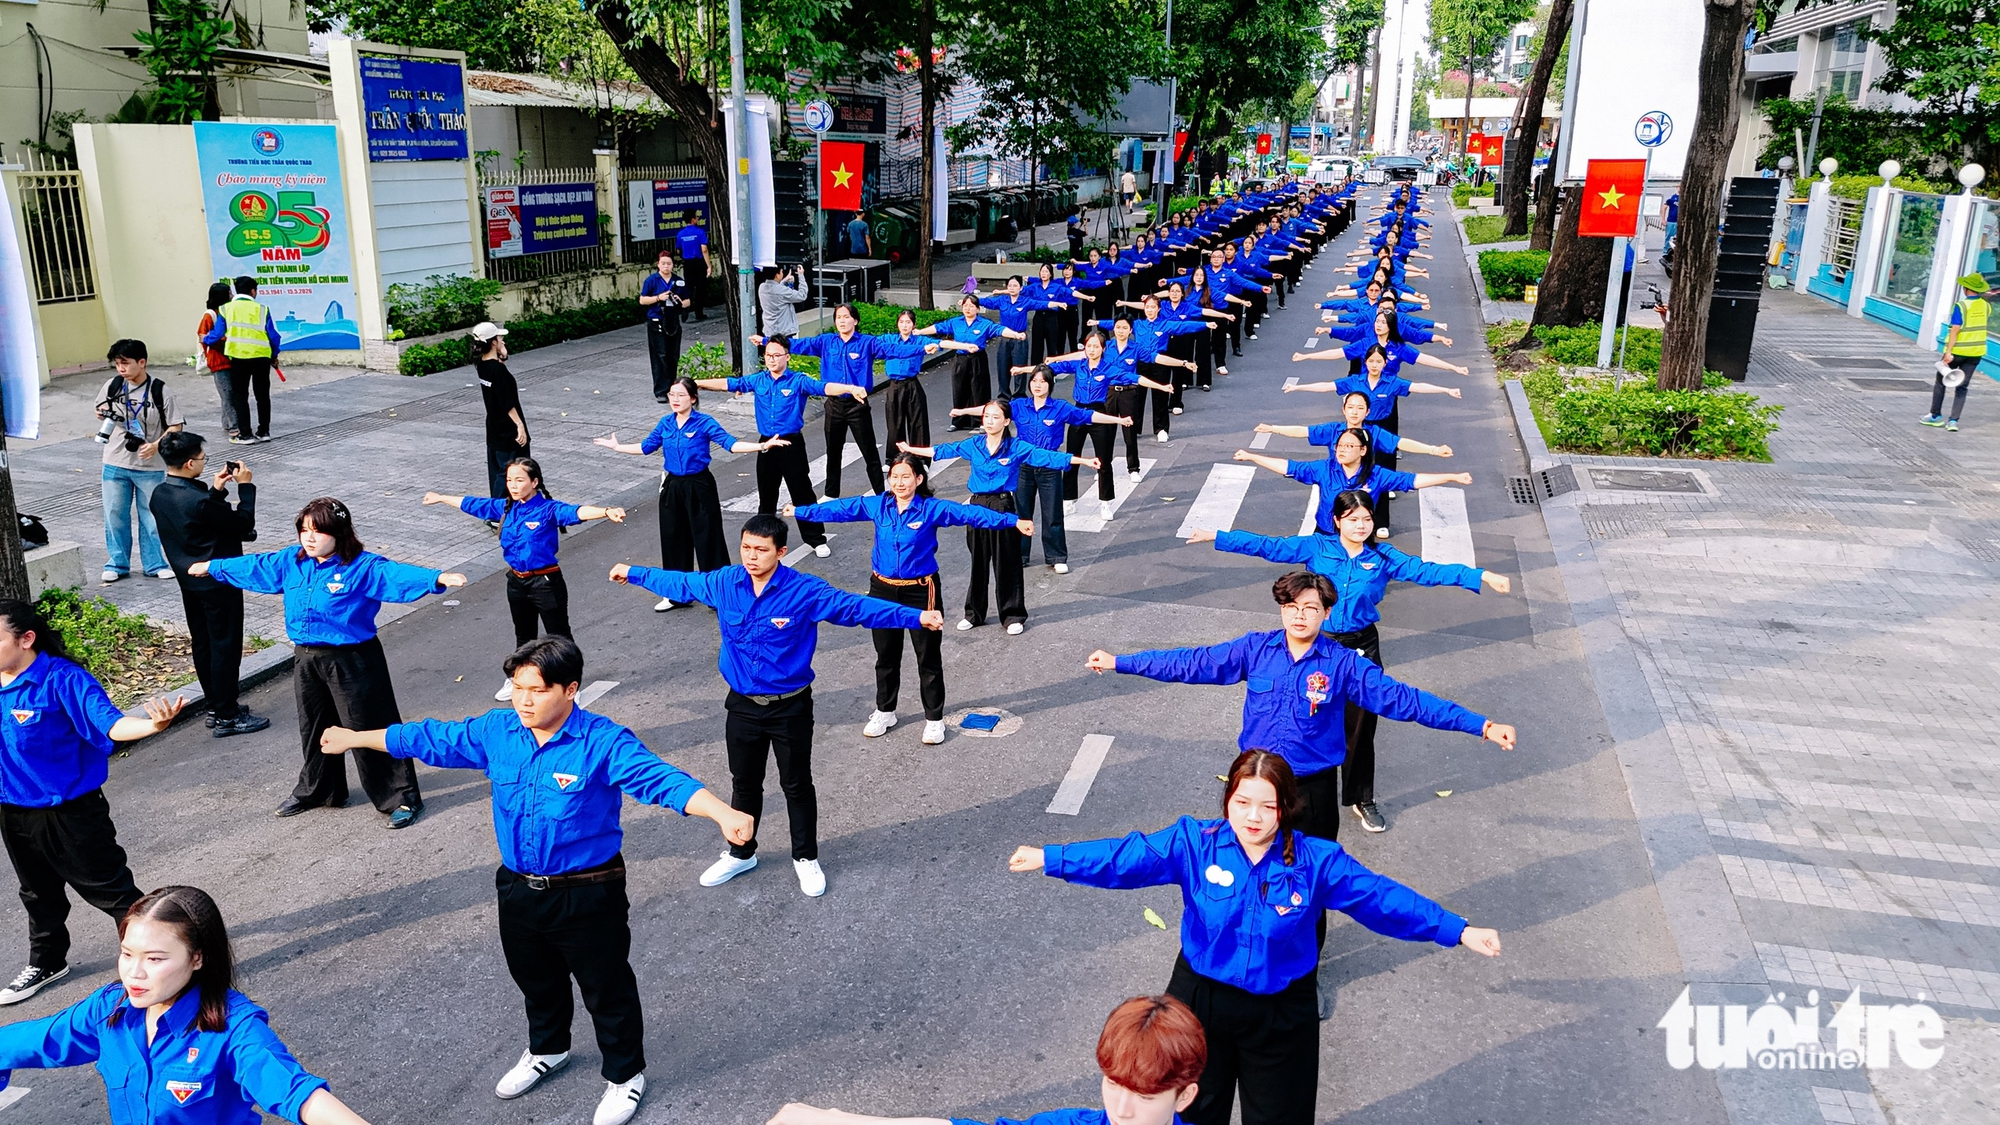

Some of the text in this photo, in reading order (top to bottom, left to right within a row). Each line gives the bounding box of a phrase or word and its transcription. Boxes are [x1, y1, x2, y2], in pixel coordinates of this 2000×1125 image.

[217, 172, 246, 186] Chào
[249, 174, 282, 188] mừng
[300, 174, 326, 184] niệm
[226, 190, 330, 258] 85
[243, 230, 271, 239] 15.5
[262, 246, 301, 260] NĂM
[257, 264, 310, 274] NGÀY THÀNH LẬP
[270, 276, 283, 284] TIỀN
[309, 274, 317, 283] HỒ
